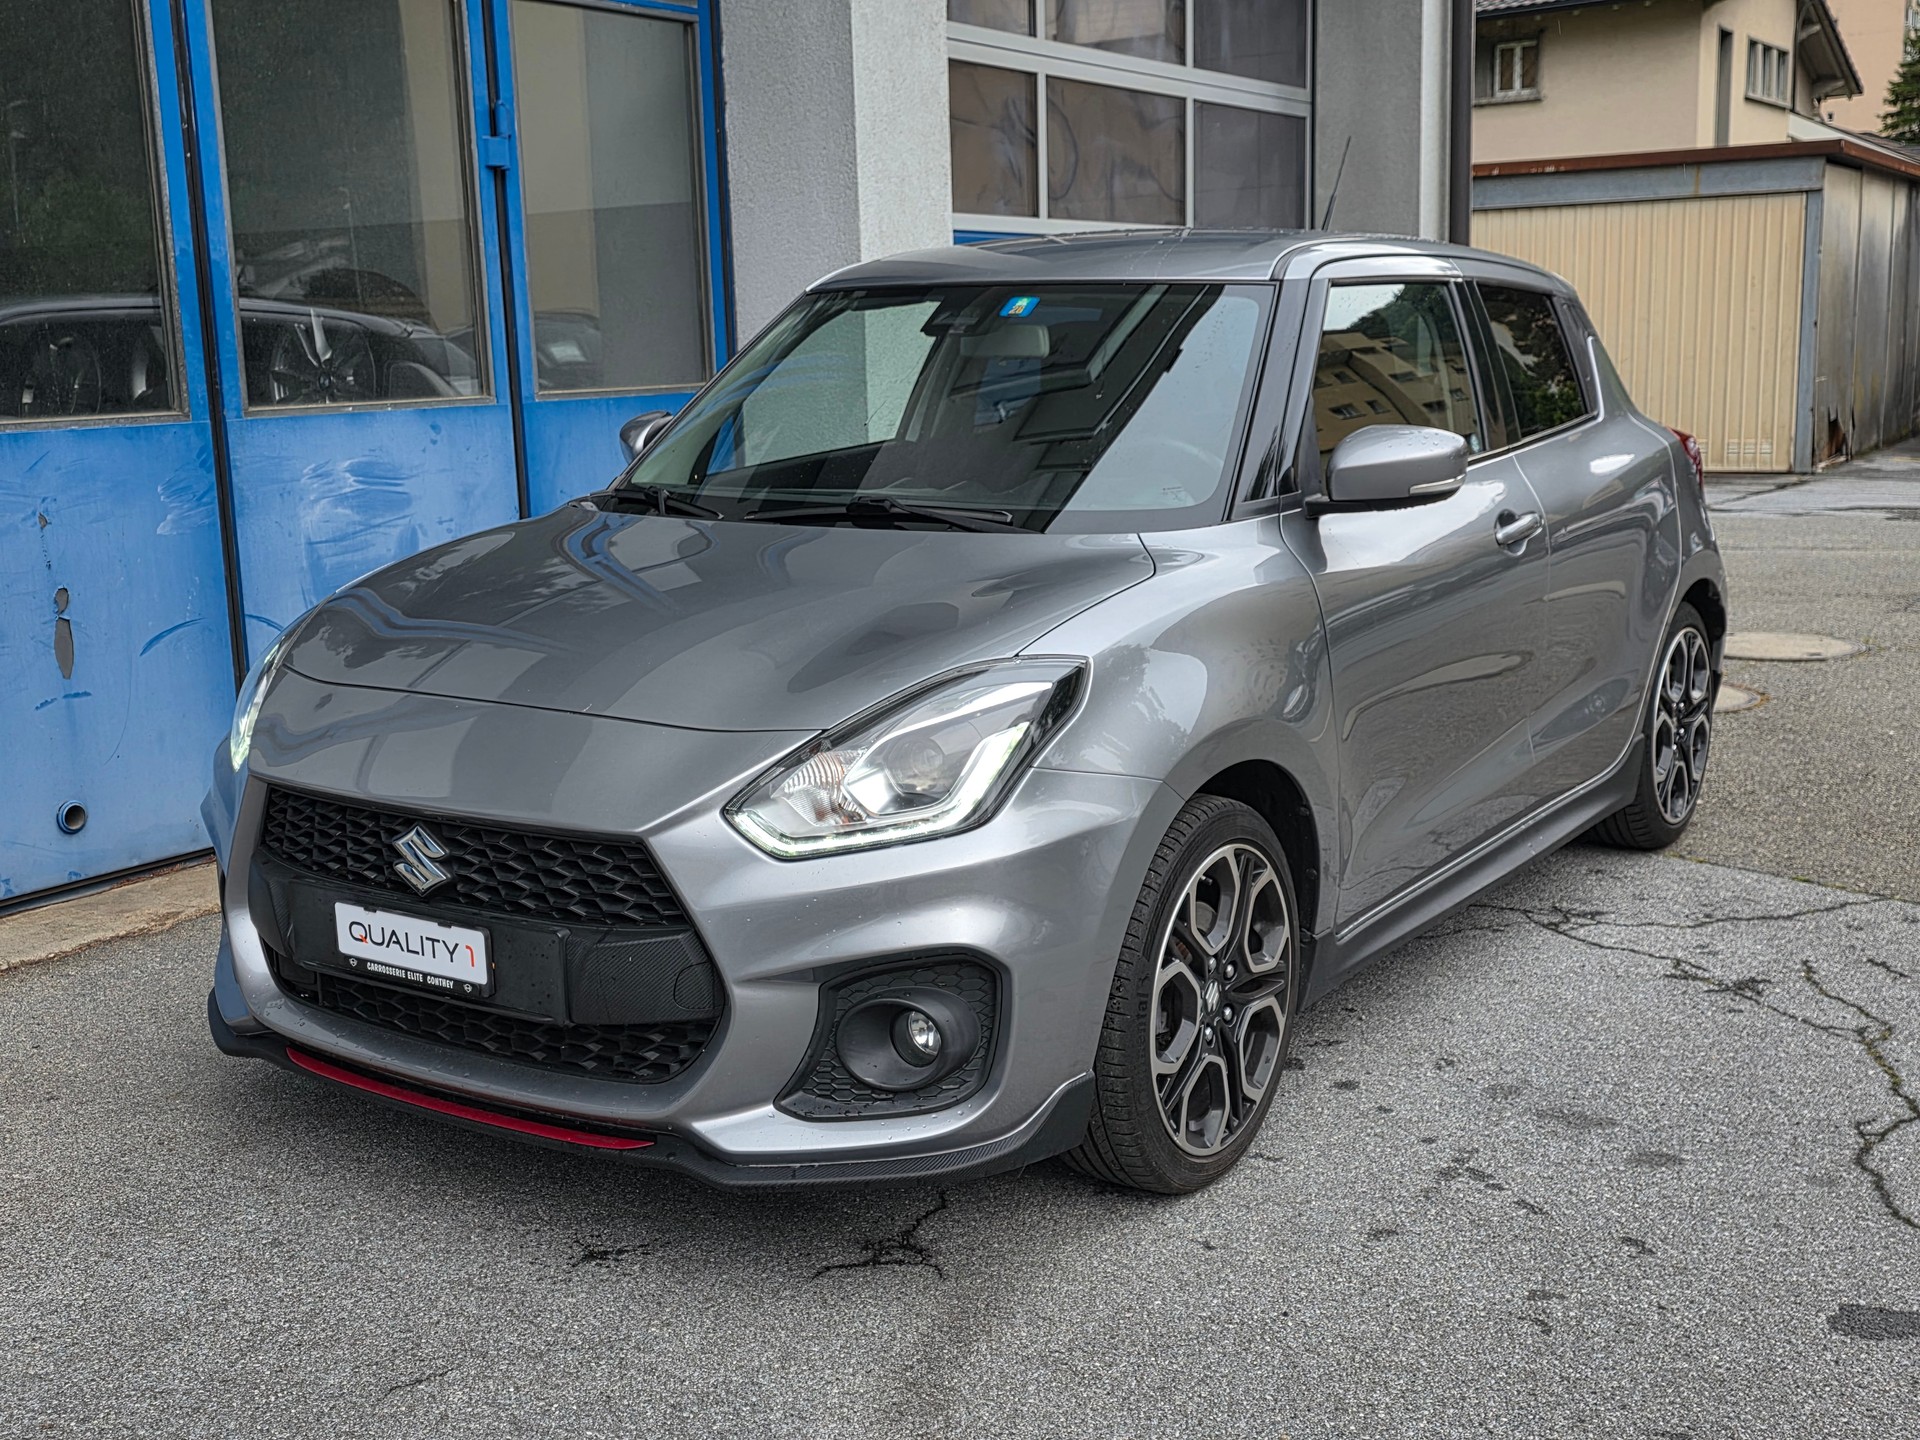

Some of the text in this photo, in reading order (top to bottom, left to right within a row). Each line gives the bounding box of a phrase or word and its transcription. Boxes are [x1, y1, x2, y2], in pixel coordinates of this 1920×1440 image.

[348, 921, 475, 968] QUALITY 1
[367, 962, 454, 989] CARROSSERIE ELITE CONTHEY
